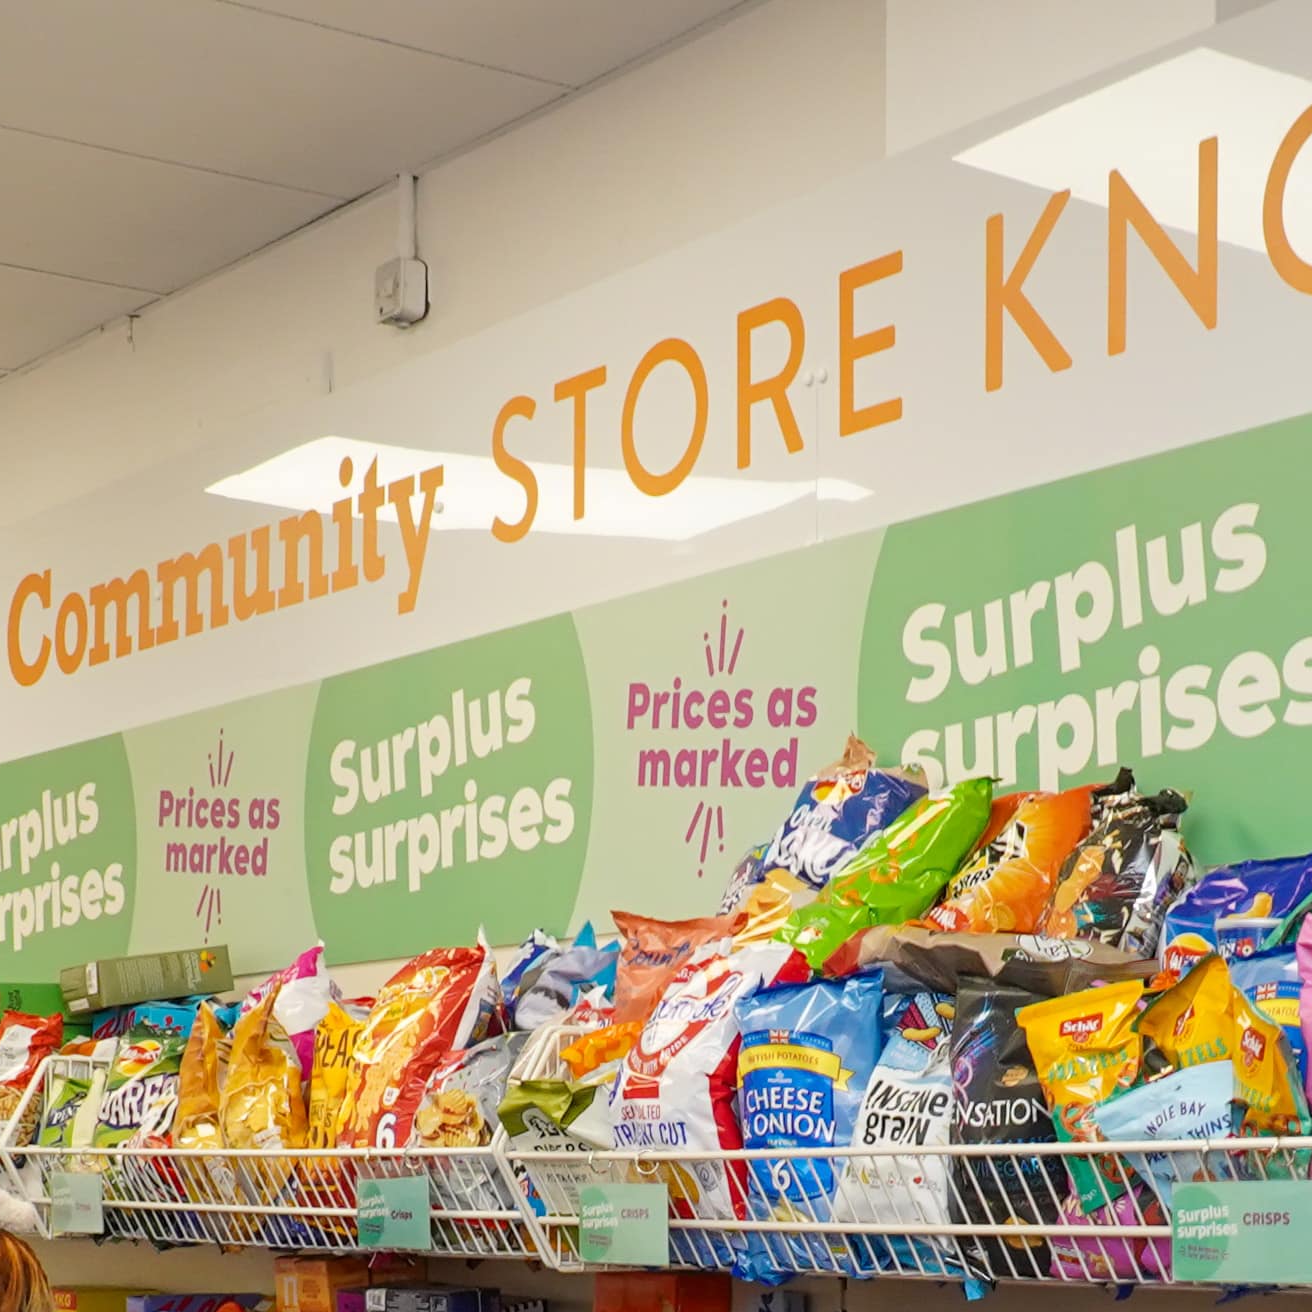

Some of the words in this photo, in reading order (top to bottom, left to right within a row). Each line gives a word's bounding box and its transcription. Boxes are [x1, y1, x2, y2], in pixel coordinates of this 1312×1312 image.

[6, 455, 445, 687] Community
[491, 249, 904, 544] STORE
[902, 501, 1267, 704] Surplus
[626, 675, 752, 731] Prices
[768, 683, 818, 729] as
[331, 676, 536, 816] Surplus
[637, 736, 799, 790] marked
[158, 789, 239, 830] Prices
[247, 795, 280, 831] as
[328, 777, 574, 895] surprises
[165, 836, 268, 877] marked
[746, 1087, 824, 1115] CHEESE
[1143, 1104, 1177, 1138] INDIE
[1180, 1101, 1207, 1117] BAY
[375, 1112, 398, 1151] 6
[659, 1121, 688, 1146] CUT
[753, 1113, 836, 1143] ONION
[1185, 1114, 1233, 1141] THINS
[391, 1208, 414, 1221] Crisps
[620, 1207, 650, 1221] CRISPS
[1177, 1205, 1230, 1224] Surplus
[1177, 1221, 1238, 1240] surprises
[1242, 1212, 1291, 1227] CRISPS
